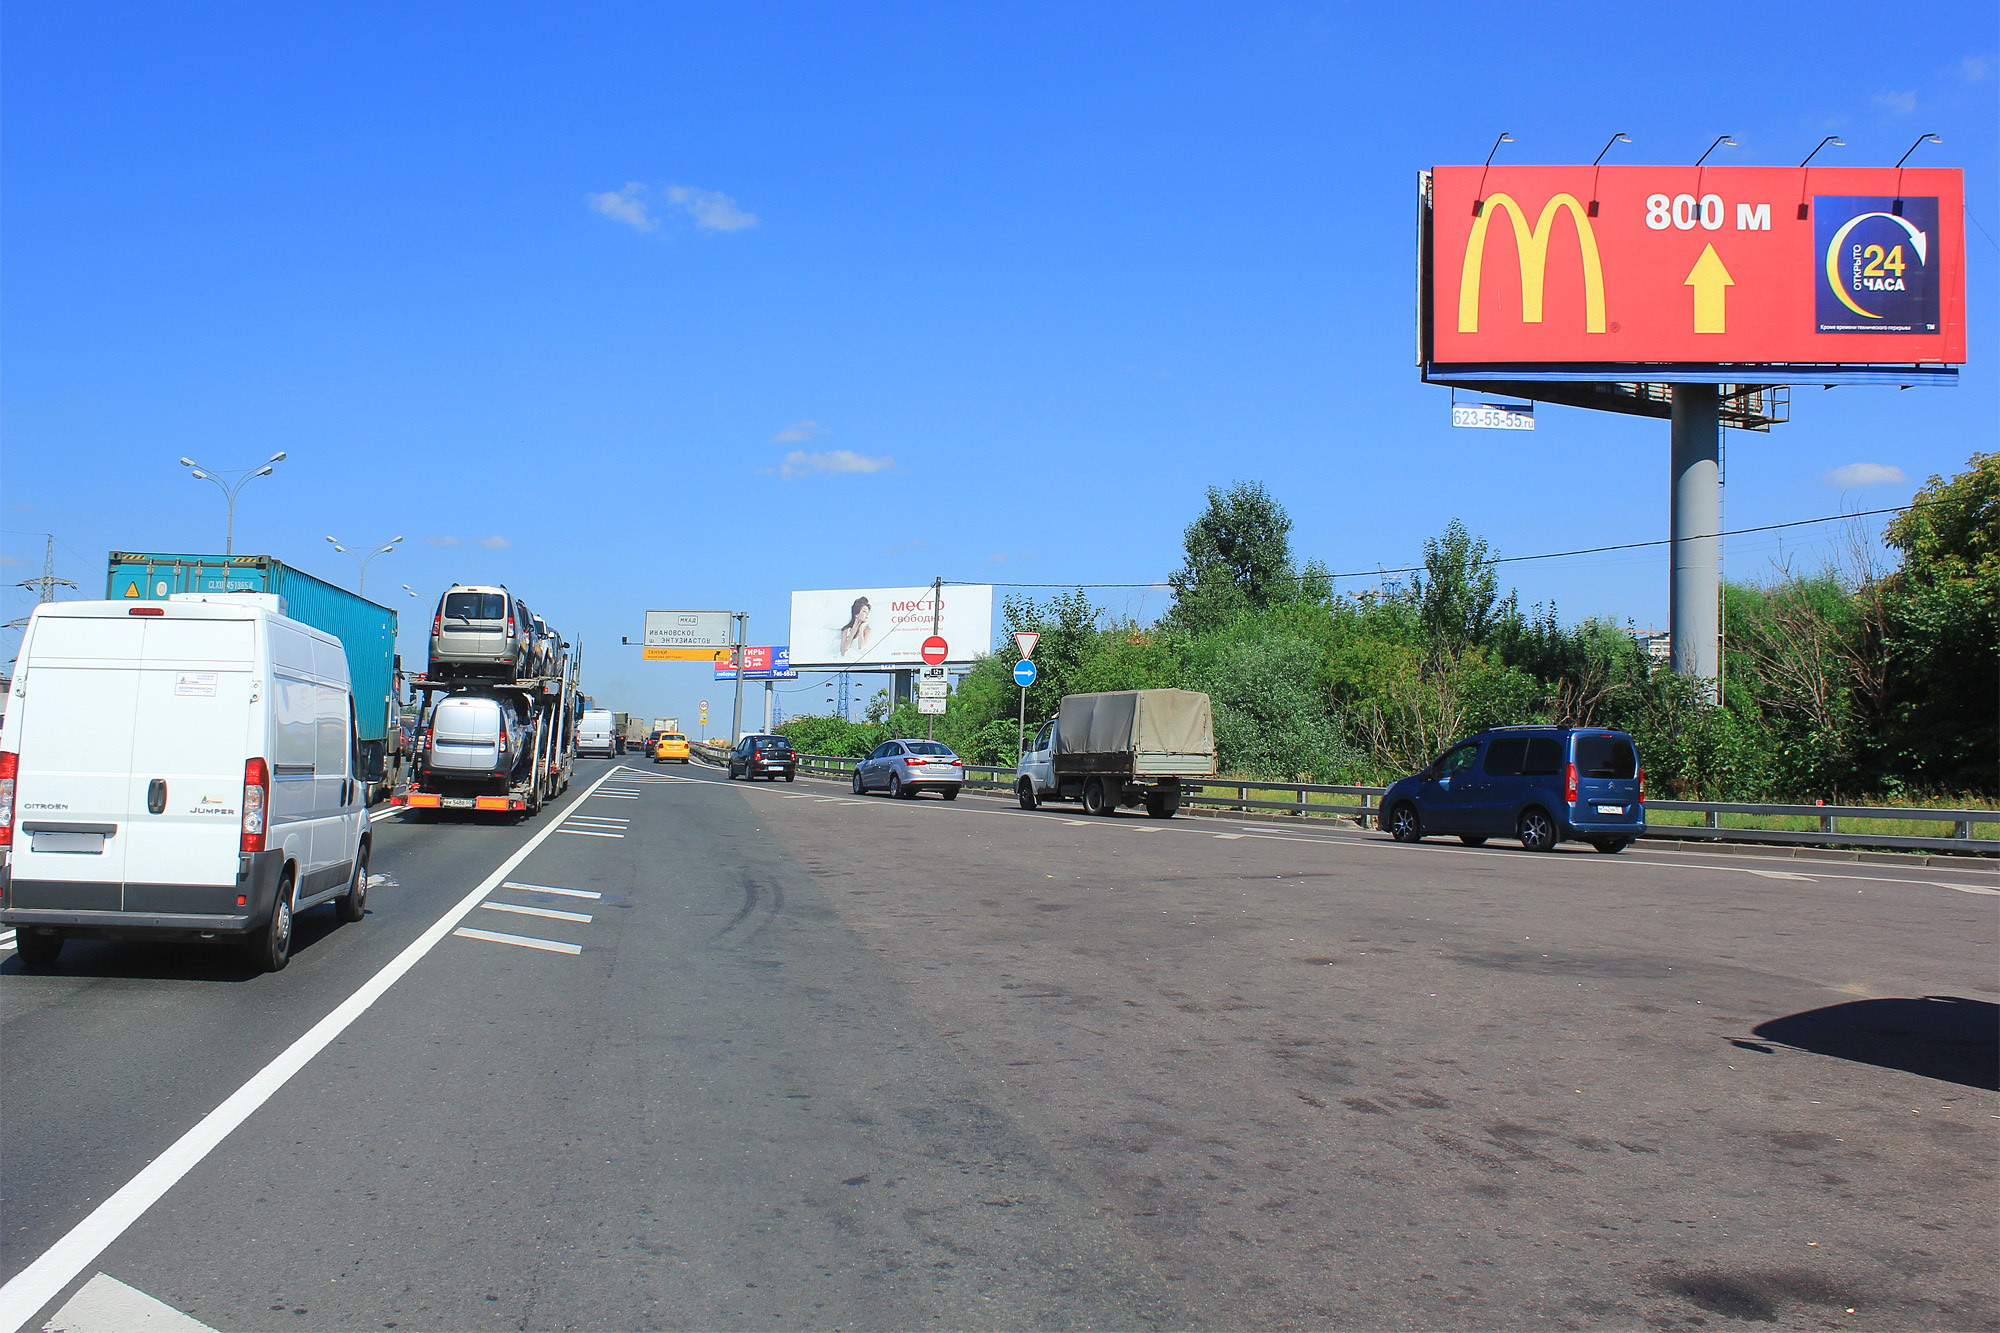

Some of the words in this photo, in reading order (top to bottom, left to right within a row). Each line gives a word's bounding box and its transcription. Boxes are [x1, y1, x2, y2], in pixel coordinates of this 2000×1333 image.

[1645, 193, 1725, 230] 800
[1863, 244, 1906, 277] 24
[1852, 244, 1862, 291] ОТКРЫТО
[1863, 278, 1906, 291] ЧАСА
[891, 600, 945, 611] место
[891, 614, 944, 623] свободно
[190, 807, 235, 815] JUMPER
